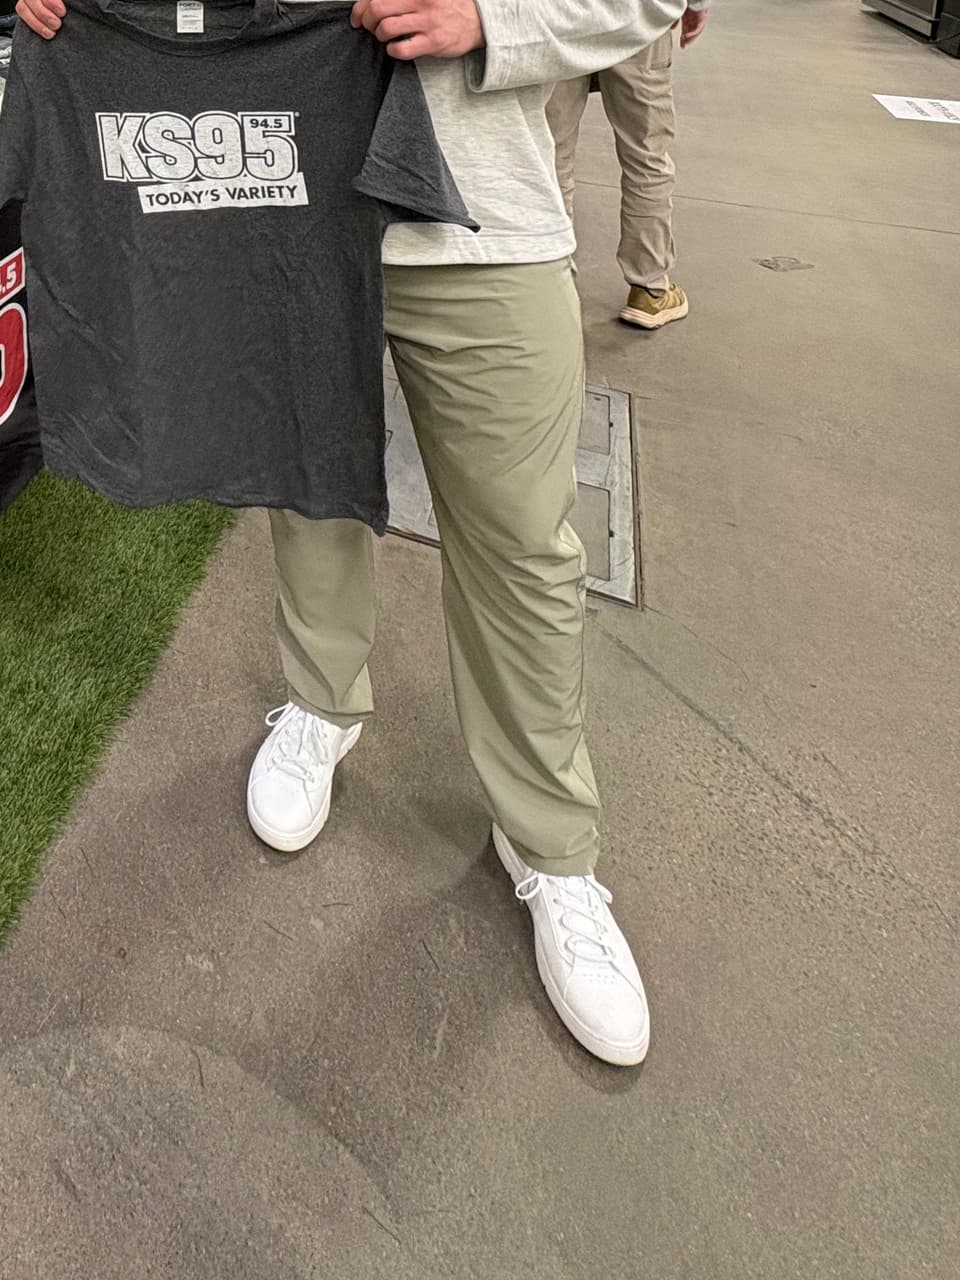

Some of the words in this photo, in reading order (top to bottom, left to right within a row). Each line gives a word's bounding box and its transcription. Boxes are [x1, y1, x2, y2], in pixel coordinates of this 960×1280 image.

[95, 110, 299, 183] KS95
[250, 119, 283, 130] 94.5
[145, 188, 221, 207] TODAY'S
[226, 185, 298, 202] VARIETY
